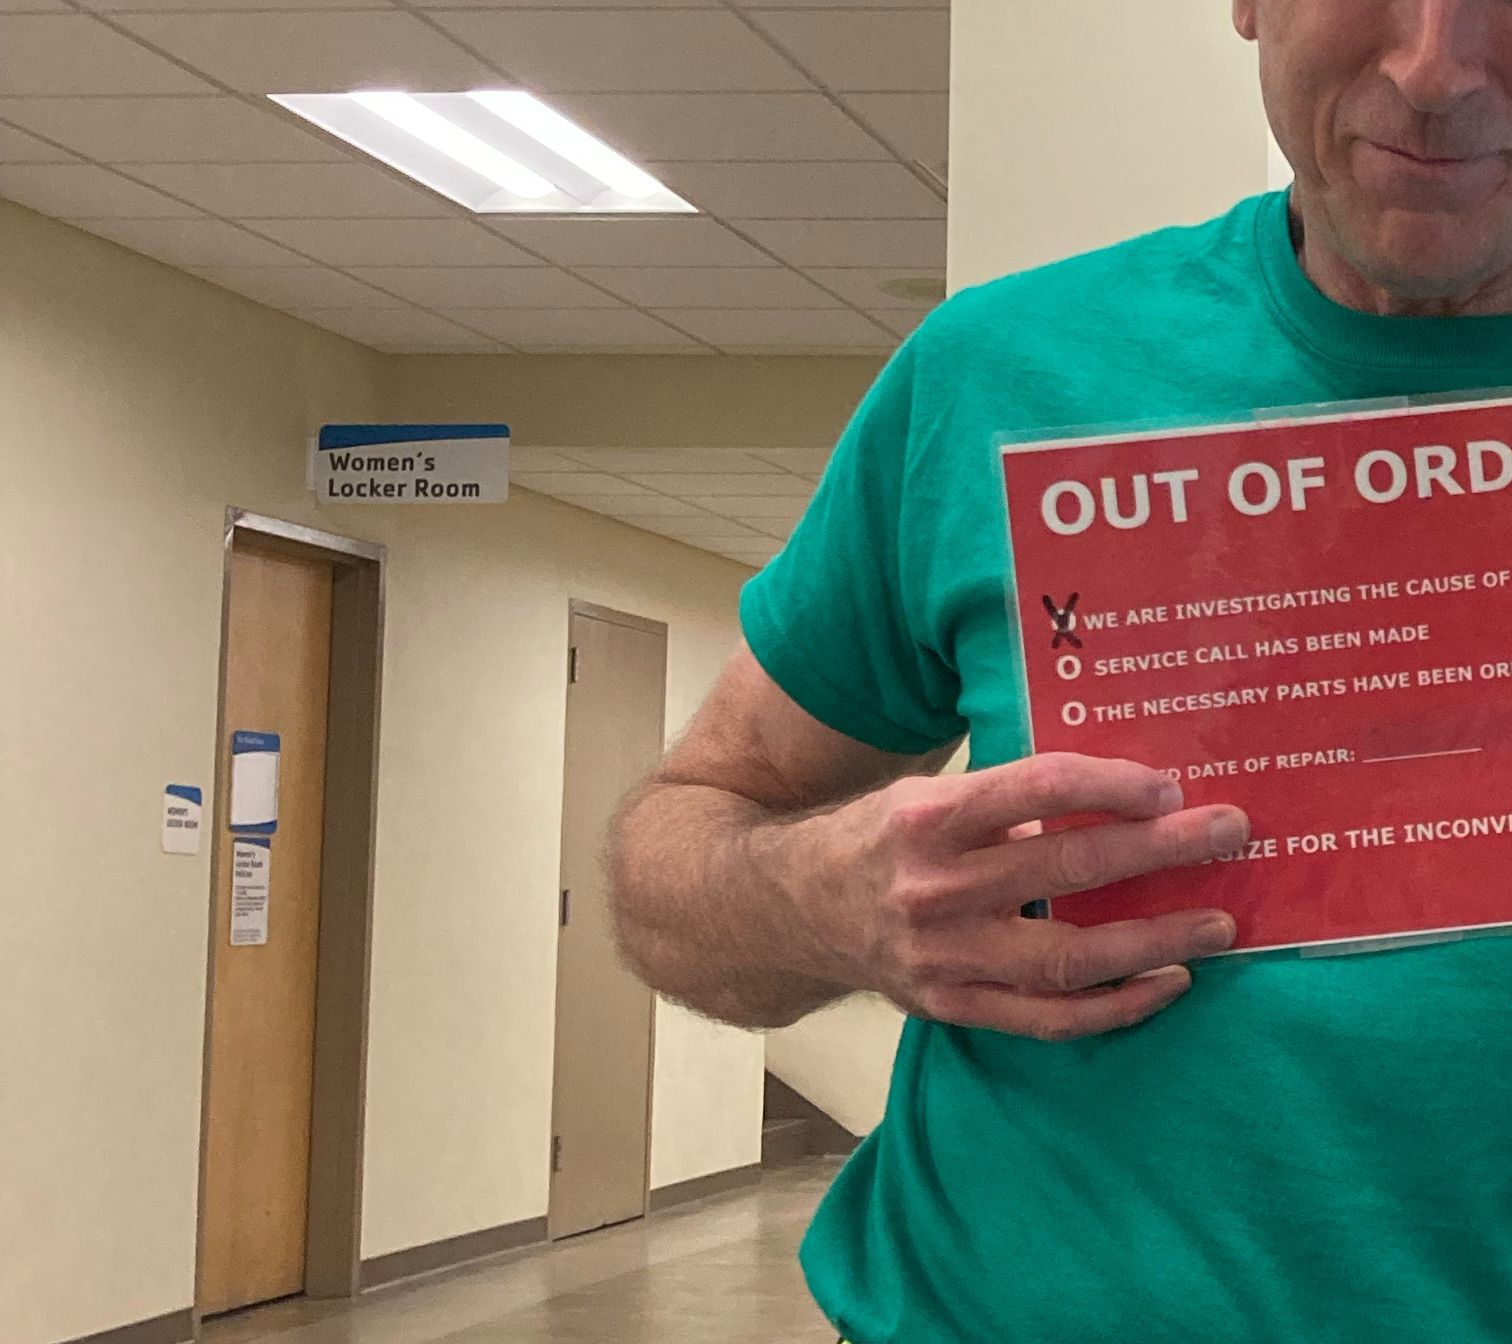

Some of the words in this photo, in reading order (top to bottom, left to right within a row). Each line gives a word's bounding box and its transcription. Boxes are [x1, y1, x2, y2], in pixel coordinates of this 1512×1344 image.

[329, 451, 435, 473] Women's
[328, 478, 407, 497] Locker
[415, 479, 480, 497] Room
[1041, 469, 1199, 536] OUT
[1228, 456, 1325, 516] OF
[1084, 612, 1119, 631] WE
[1126, 605, 1169, 625] ARE
[1175, 587, 1351, 621] INVESTIGATING
[1357, 582, 1400, 601] THE
[1405, 574, 1476, 596] CAUSE
[1482, 570, 1511, 588] OF
[1094, 651, 1188, 676] SERVICE
[1195, 644, 1249, 665] CALL
[1255, 637, 1299, 657] HAS
[1306, 631, 1361, 651] BEEN
[1369, 624, 1430, 646] MADE
[1093, 703, 1136, 723] THE
[1143, 687, 1269, 717] NECESSARY
[1277, 678, 1347, 701] PARTS
[1353, 671, 1410, 693] HAVE
[1417, 665, 1473, 686] BEEN
[1187, 760, 1239, 780] DATE
[1243, 756, 1270, 773] OF
[1276, 748, 1355, 770] REPAIR:
[1286, 832, 1338, 856] FOR
[1345, 826, 1395, 849] THE
